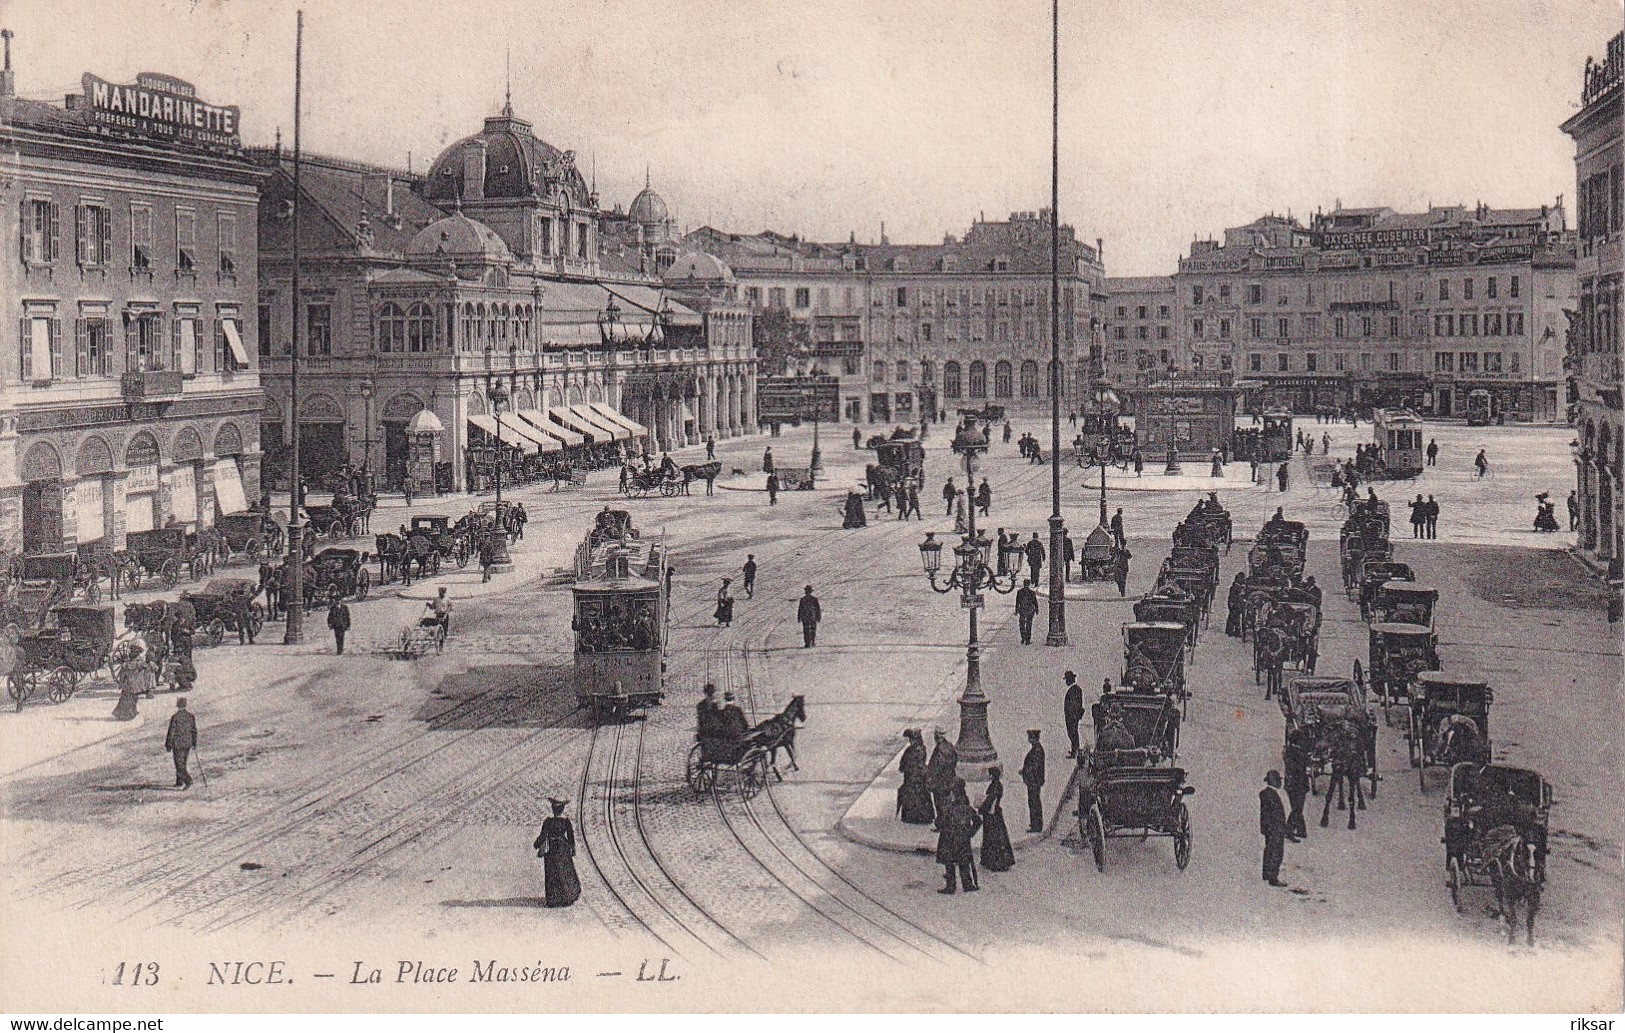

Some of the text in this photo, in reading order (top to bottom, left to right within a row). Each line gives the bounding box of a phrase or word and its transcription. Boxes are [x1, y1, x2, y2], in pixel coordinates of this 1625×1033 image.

[93, 82, 233, 133] MANDARINETTE
[153, 123, 173, 135] TOUS
[1376, 229, 1425, 242] CUSENIER
